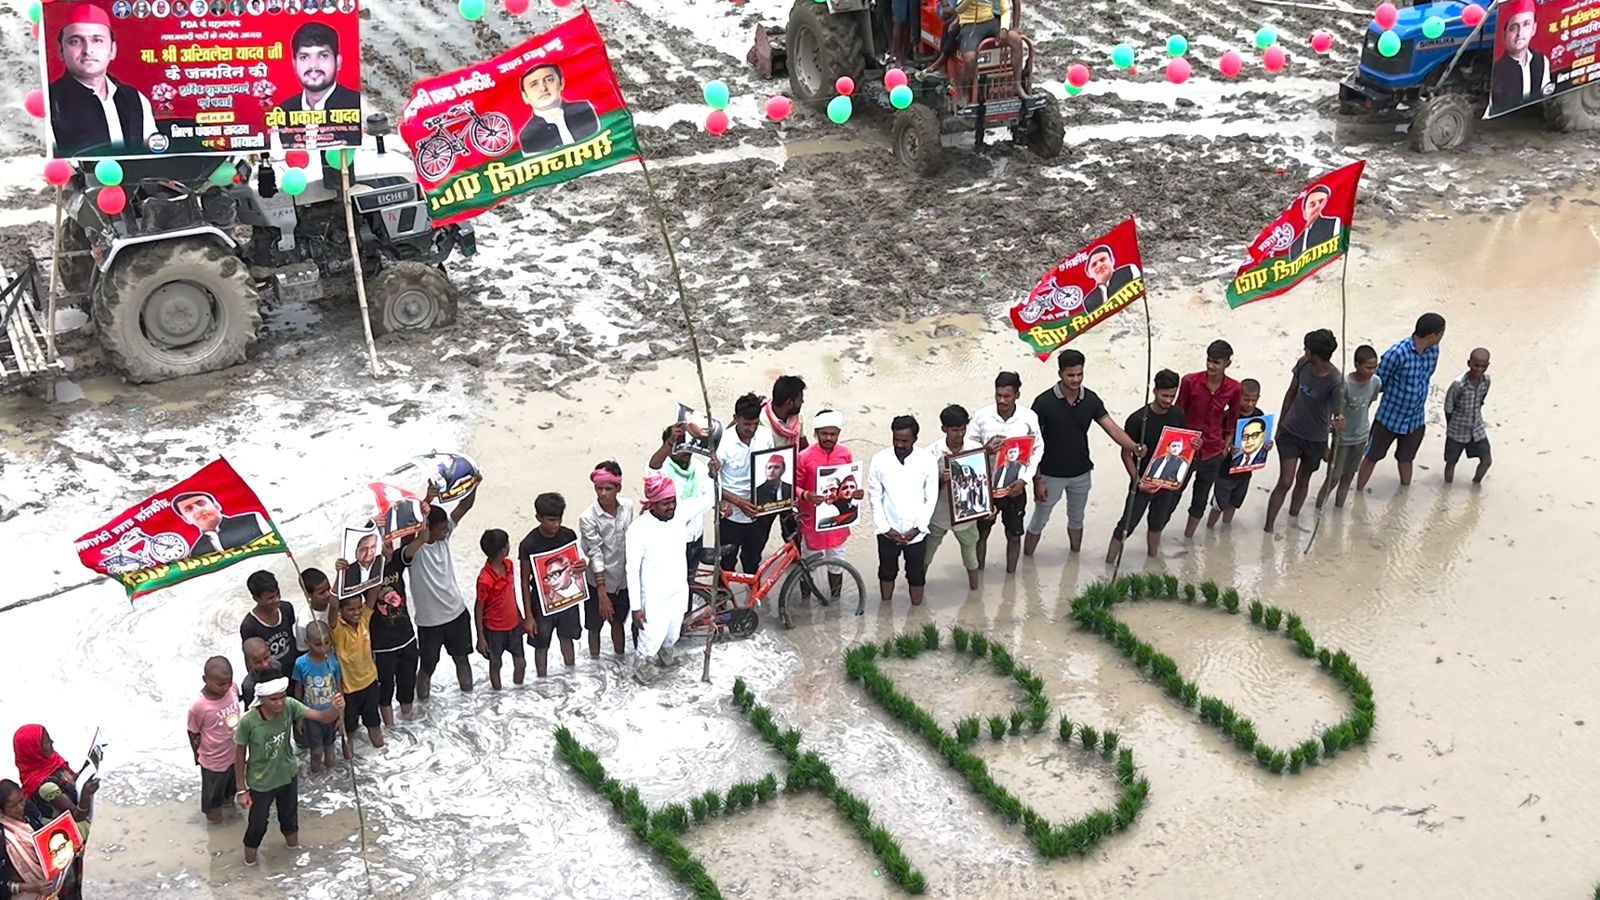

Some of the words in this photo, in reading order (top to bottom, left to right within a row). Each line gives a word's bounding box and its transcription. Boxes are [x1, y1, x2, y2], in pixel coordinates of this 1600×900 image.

[180, 20, 198, 28] PDA
[140, 48, 158, 62] मा.
[162, 44, 178, 62] श्री
[180, 43, 233, 62] अखिलेश
[236, 46, 264, 60] यादव
[267, 41, 282, 60] जी
[165, 64, 180, 80] के
[184, 63, 244, 79] जन्मदिन
[248, 62, 268, 78] की
[265, 106, 286, 127] रवि
[289, 110, 326, 126] प्रकाश
[330, 109, 360, 124] यादव
[378, 191, 408, 205] EICHER
[270, 637, 286, 655] 99
